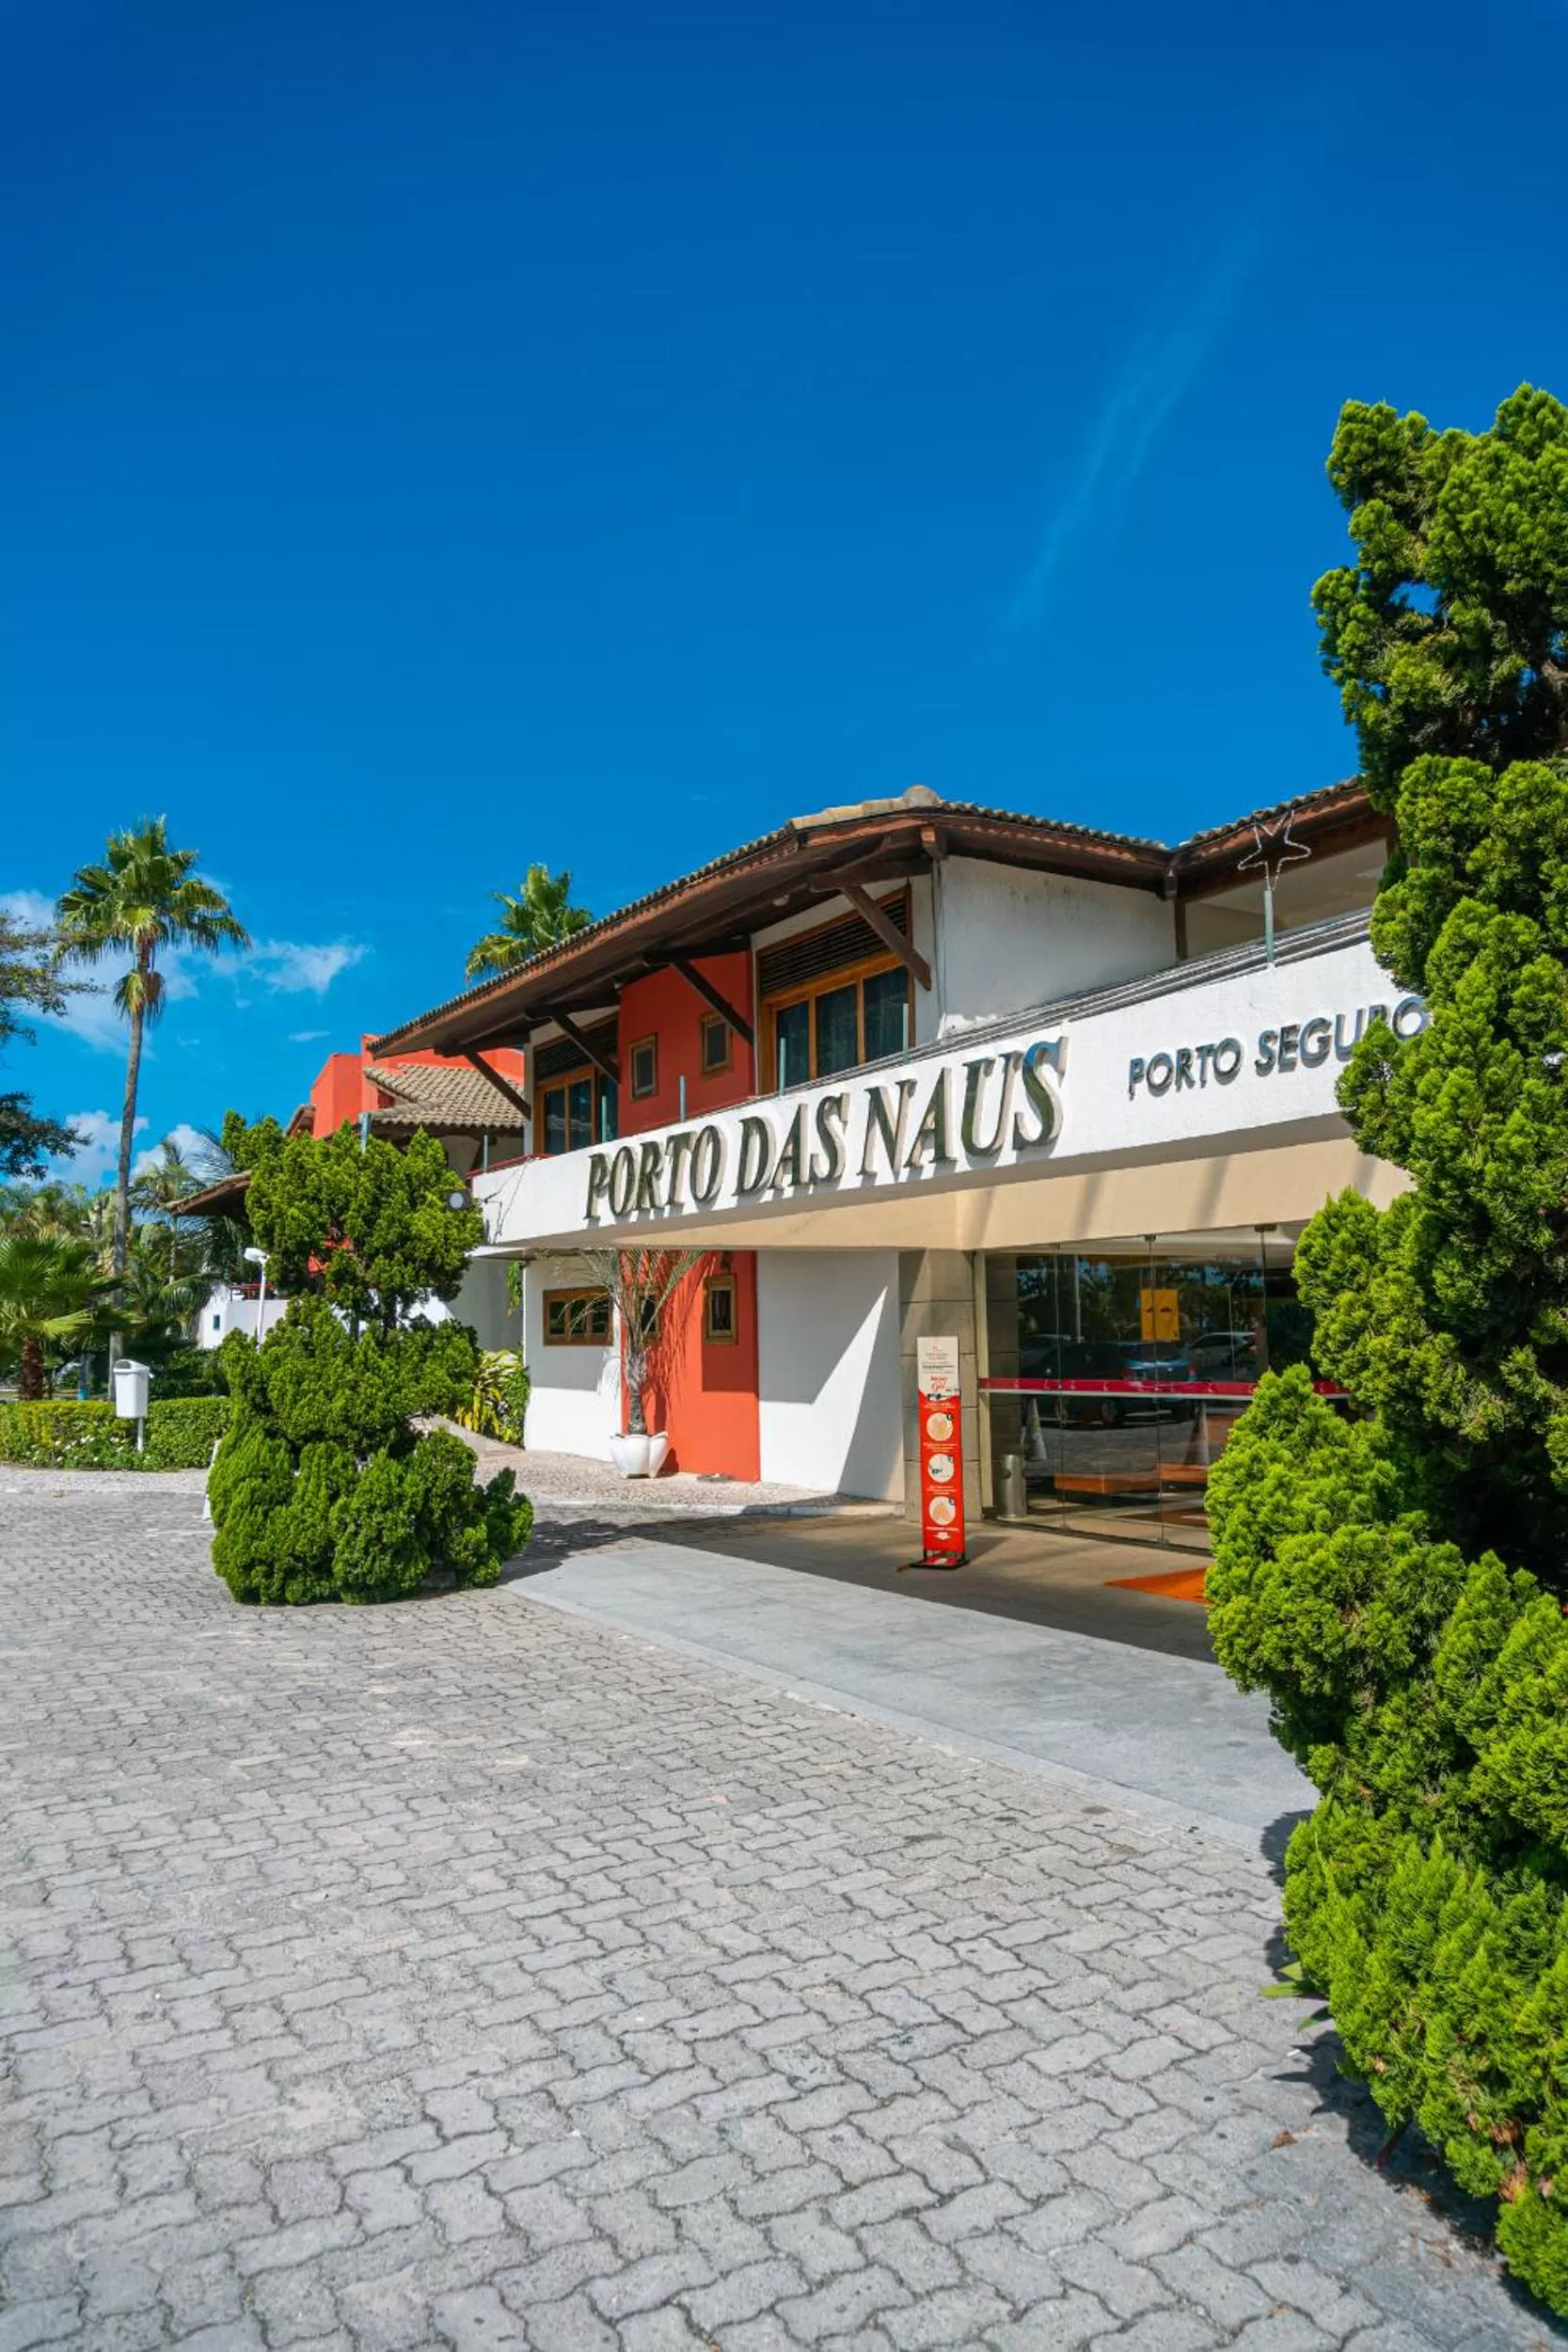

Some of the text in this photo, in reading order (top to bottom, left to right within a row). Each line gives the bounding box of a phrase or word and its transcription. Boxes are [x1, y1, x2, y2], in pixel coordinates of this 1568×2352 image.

[584, 1036, 1069, 1220] PORTO DAS NAUS
[1128, 1038, 1243, 1101] PORTO
